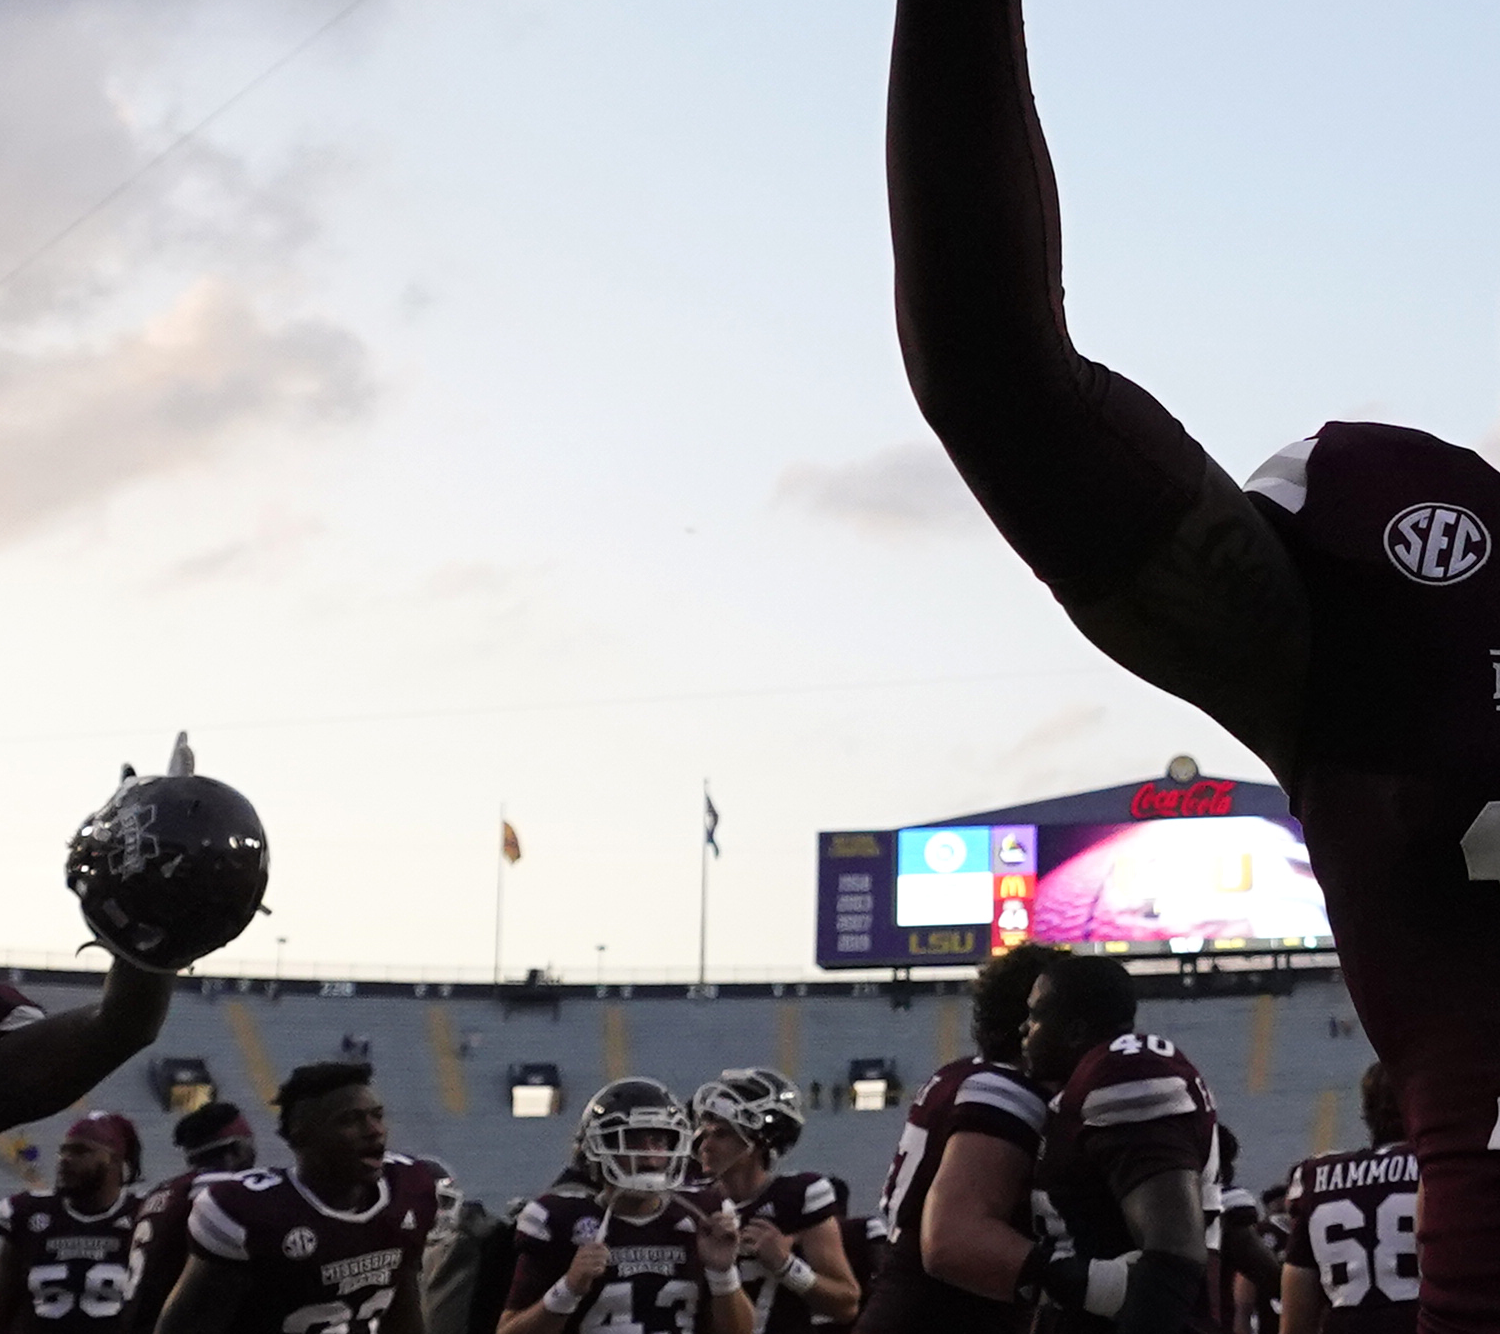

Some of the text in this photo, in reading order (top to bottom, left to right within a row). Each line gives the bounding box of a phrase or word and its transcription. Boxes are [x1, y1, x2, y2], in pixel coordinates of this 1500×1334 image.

[1394, 508, 1482, 577] SEC
[908, 931, 975, 955] LSU
[1308, 1192, 1420, 1309] 68
